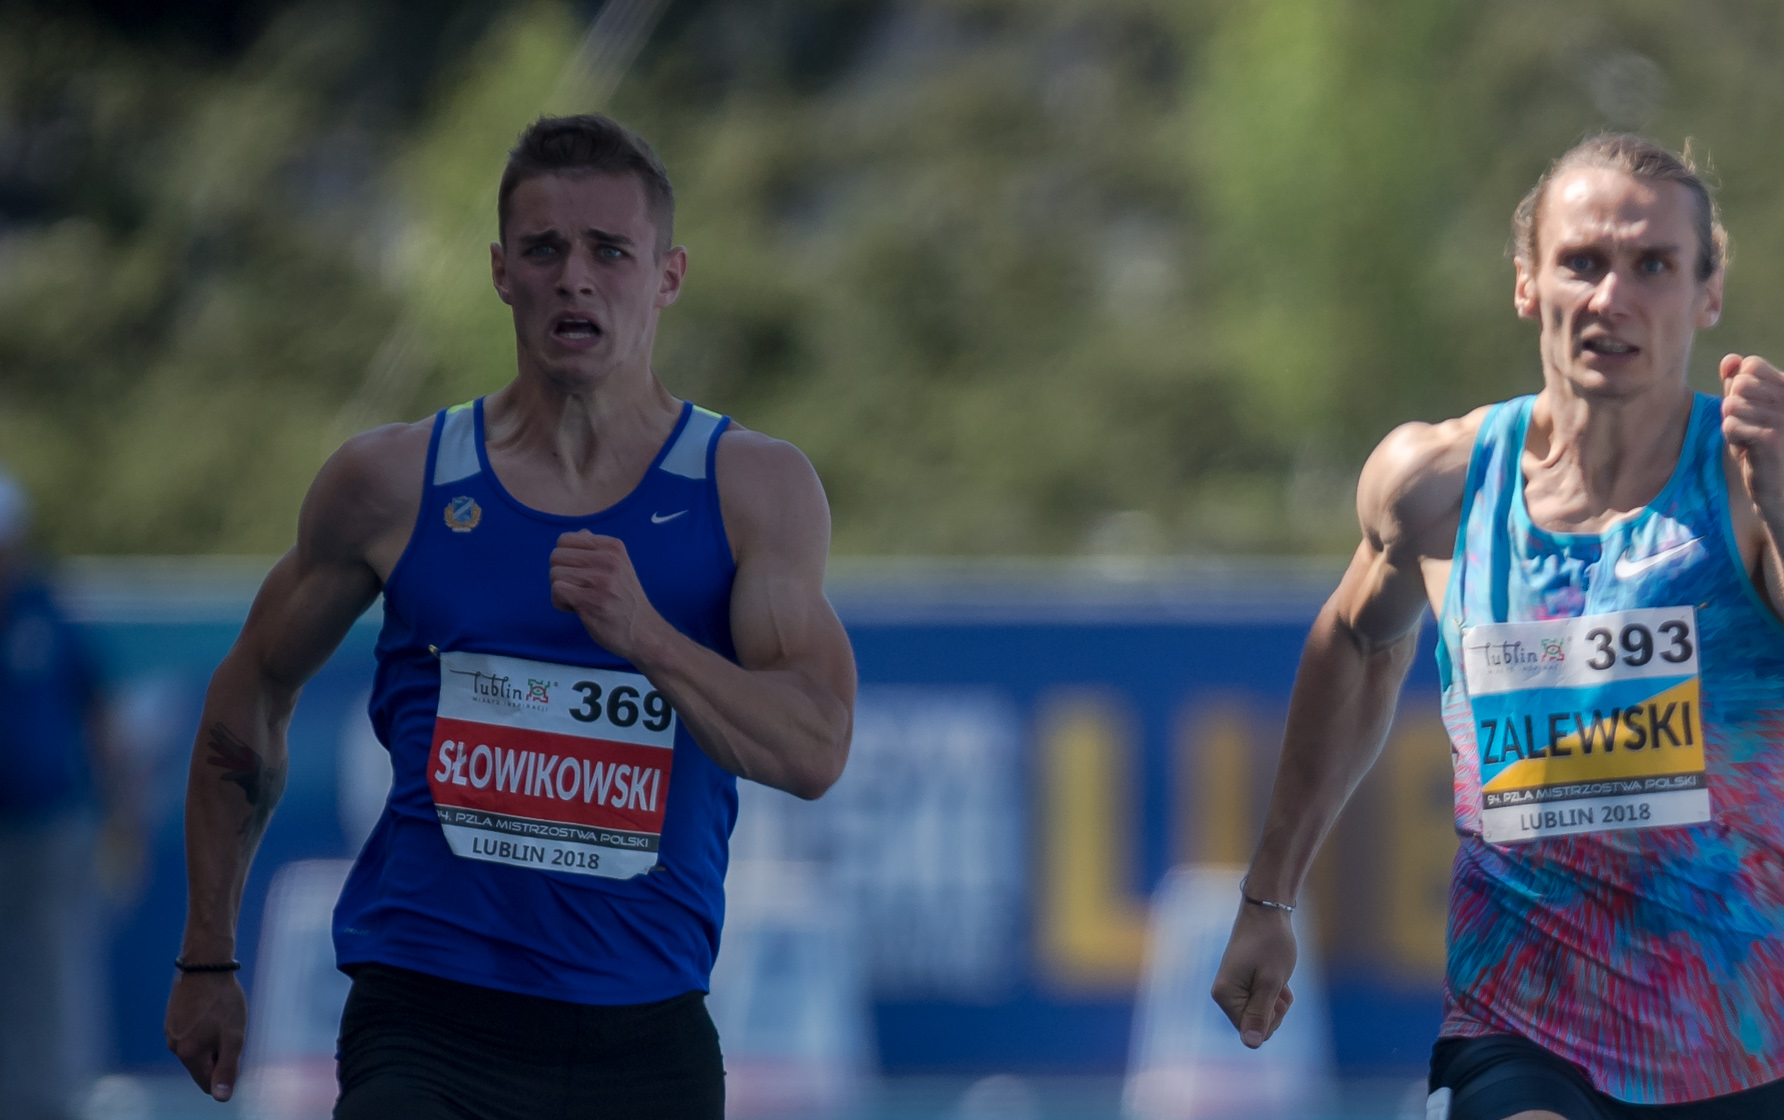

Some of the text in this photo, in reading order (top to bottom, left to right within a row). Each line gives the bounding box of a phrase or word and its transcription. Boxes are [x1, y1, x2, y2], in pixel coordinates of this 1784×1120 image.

[1585, 619, 1694, 671] 393
[568, 680, 673, 733] 369
[1480, 701, 1695, 766] ZALEWSKI
[434, 738, 662, 813] SŁOWIKOWSKI
[1503, 789, 1535, 804] PZLA
[1536, 780, 1643, 800] MISTRZOSTWA
[1645, 775, 1697, 790] POLSKI
[455, 811, 493, 827] PZLA
[495, 819, 598, 842] MISTRZOSTWA
[600, 833, 650, 849] POLSKI
[1520, 803, 1652, 832] LUBLIN 2018
[472, 836, 601, 871] LUBLIN 2018
